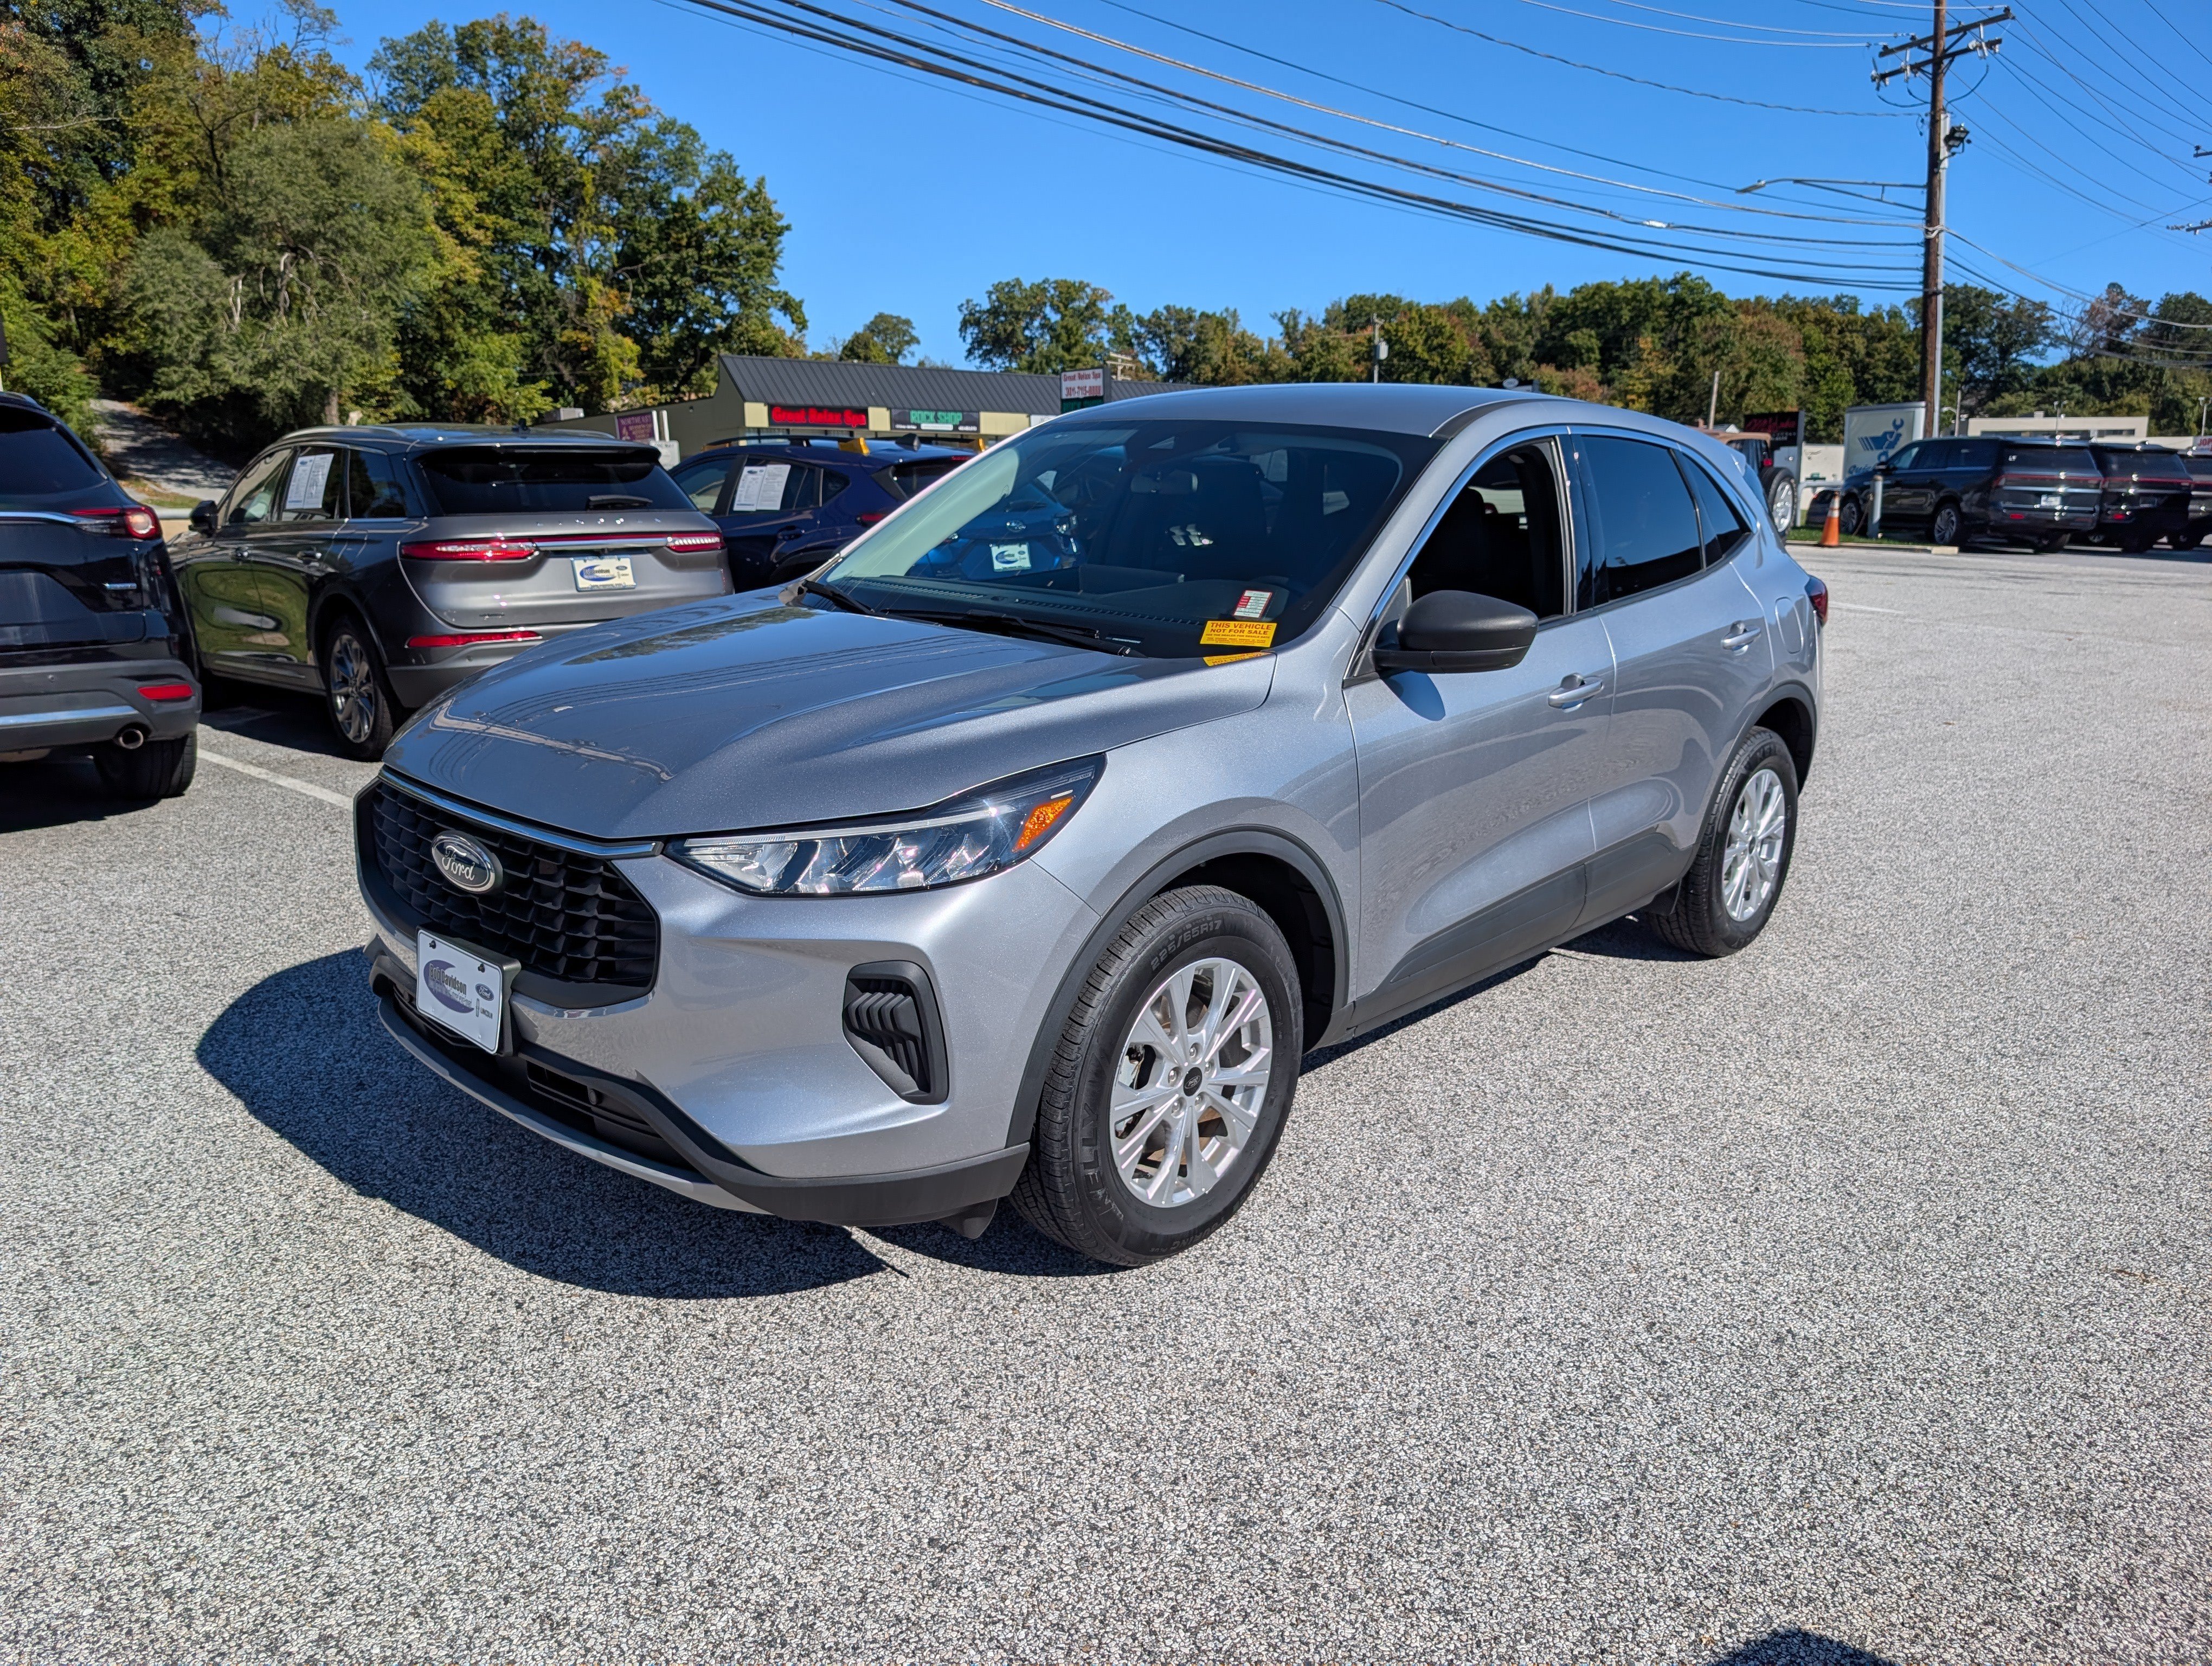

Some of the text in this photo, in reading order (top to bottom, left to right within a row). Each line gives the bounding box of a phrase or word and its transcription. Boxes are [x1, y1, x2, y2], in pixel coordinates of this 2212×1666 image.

[772, 407, 866, 428] Great Relax Spa
[910, 409, 963, 426] ROCK SHOP
[441, 845, 475, 881] Ford
[1150, 920, 1222, 971] 225/65R17
[429, 963, 441, 982] Bob
[441, 969, 467, 996] Davidson
[480, 985, 492, 998] Ford
[480, 1007, 493, 1020] LINCOLN
